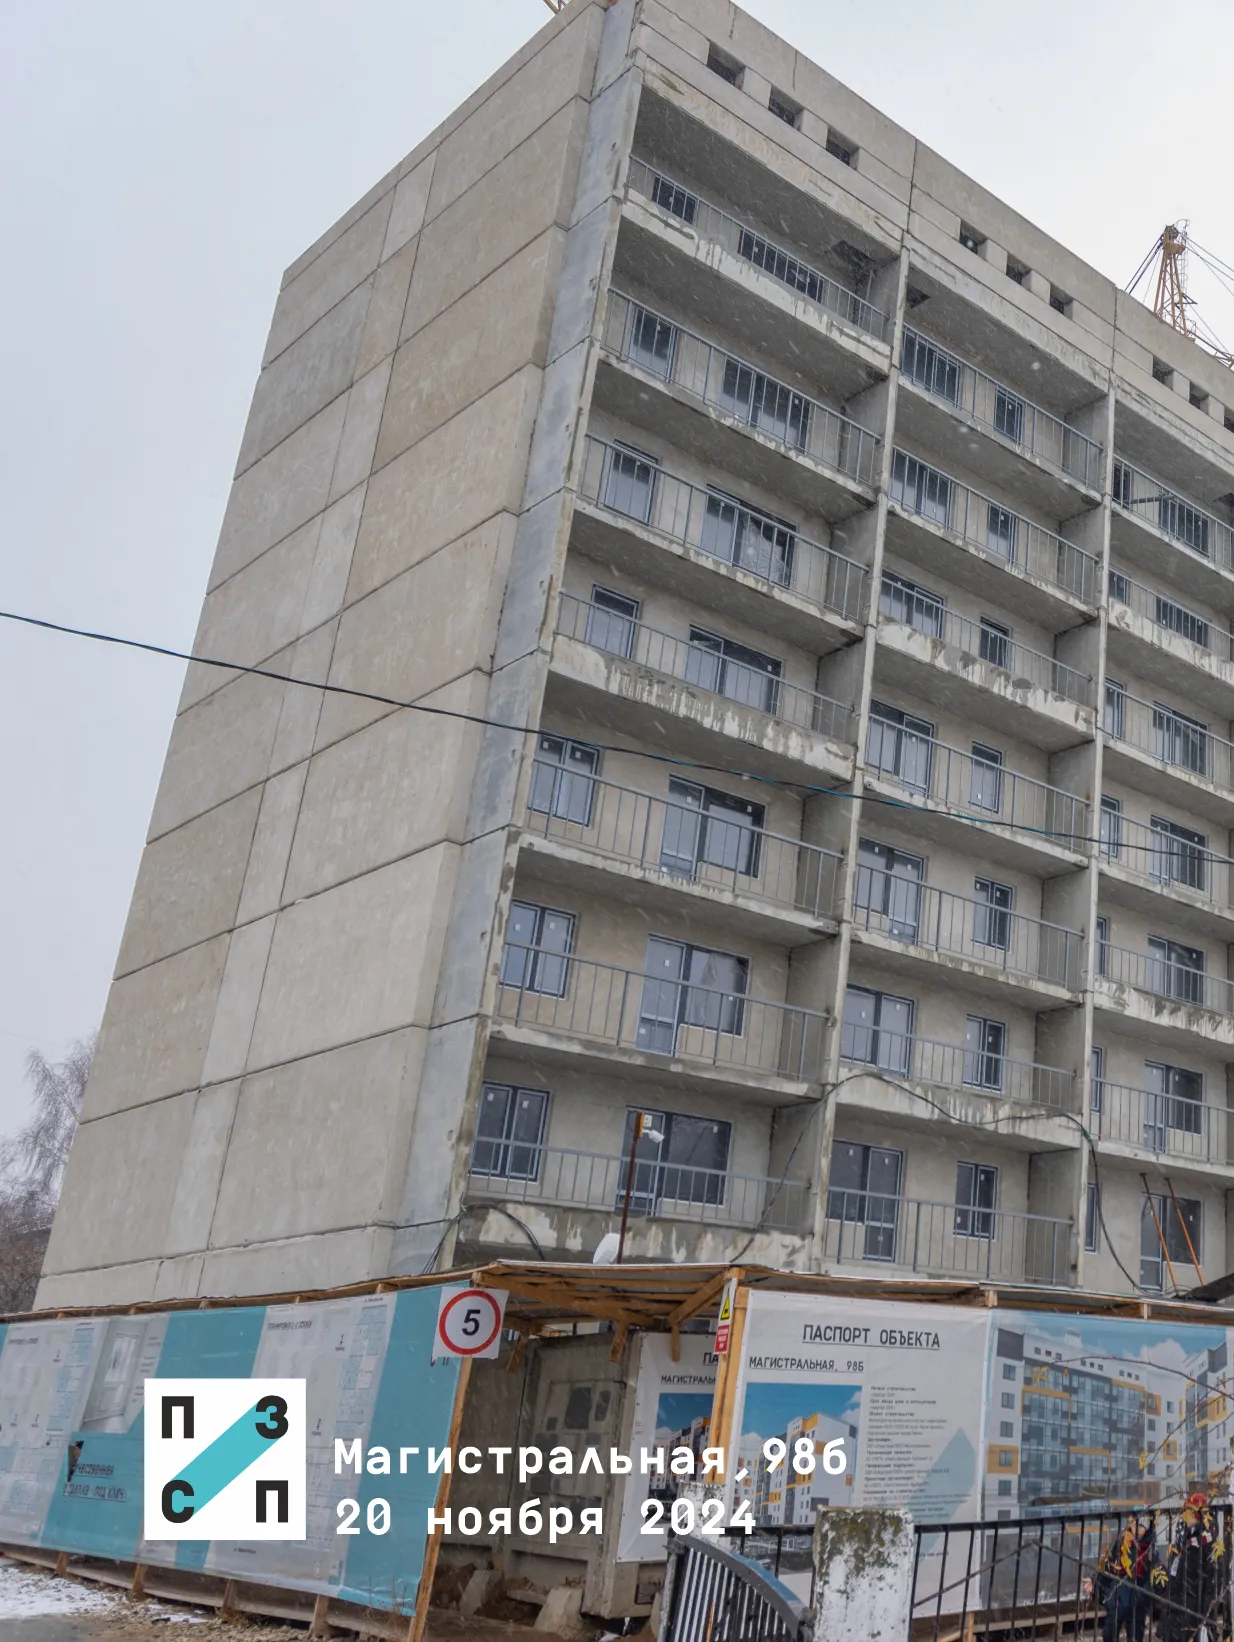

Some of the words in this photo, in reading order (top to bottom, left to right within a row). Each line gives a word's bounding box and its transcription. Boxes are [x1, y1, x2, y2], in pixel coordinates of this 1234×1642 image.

[461, 1308, 481, 1337] 5
[802, 1324, 871, 1344] ПАСПОРТ
[879, 1329, 941, 1348] ОБЪЕКТА
[749, 1356, 838, 1372] МАГИСТРАЛЬНАЯ,
[846, 1360, 864, 1372] 98Б
